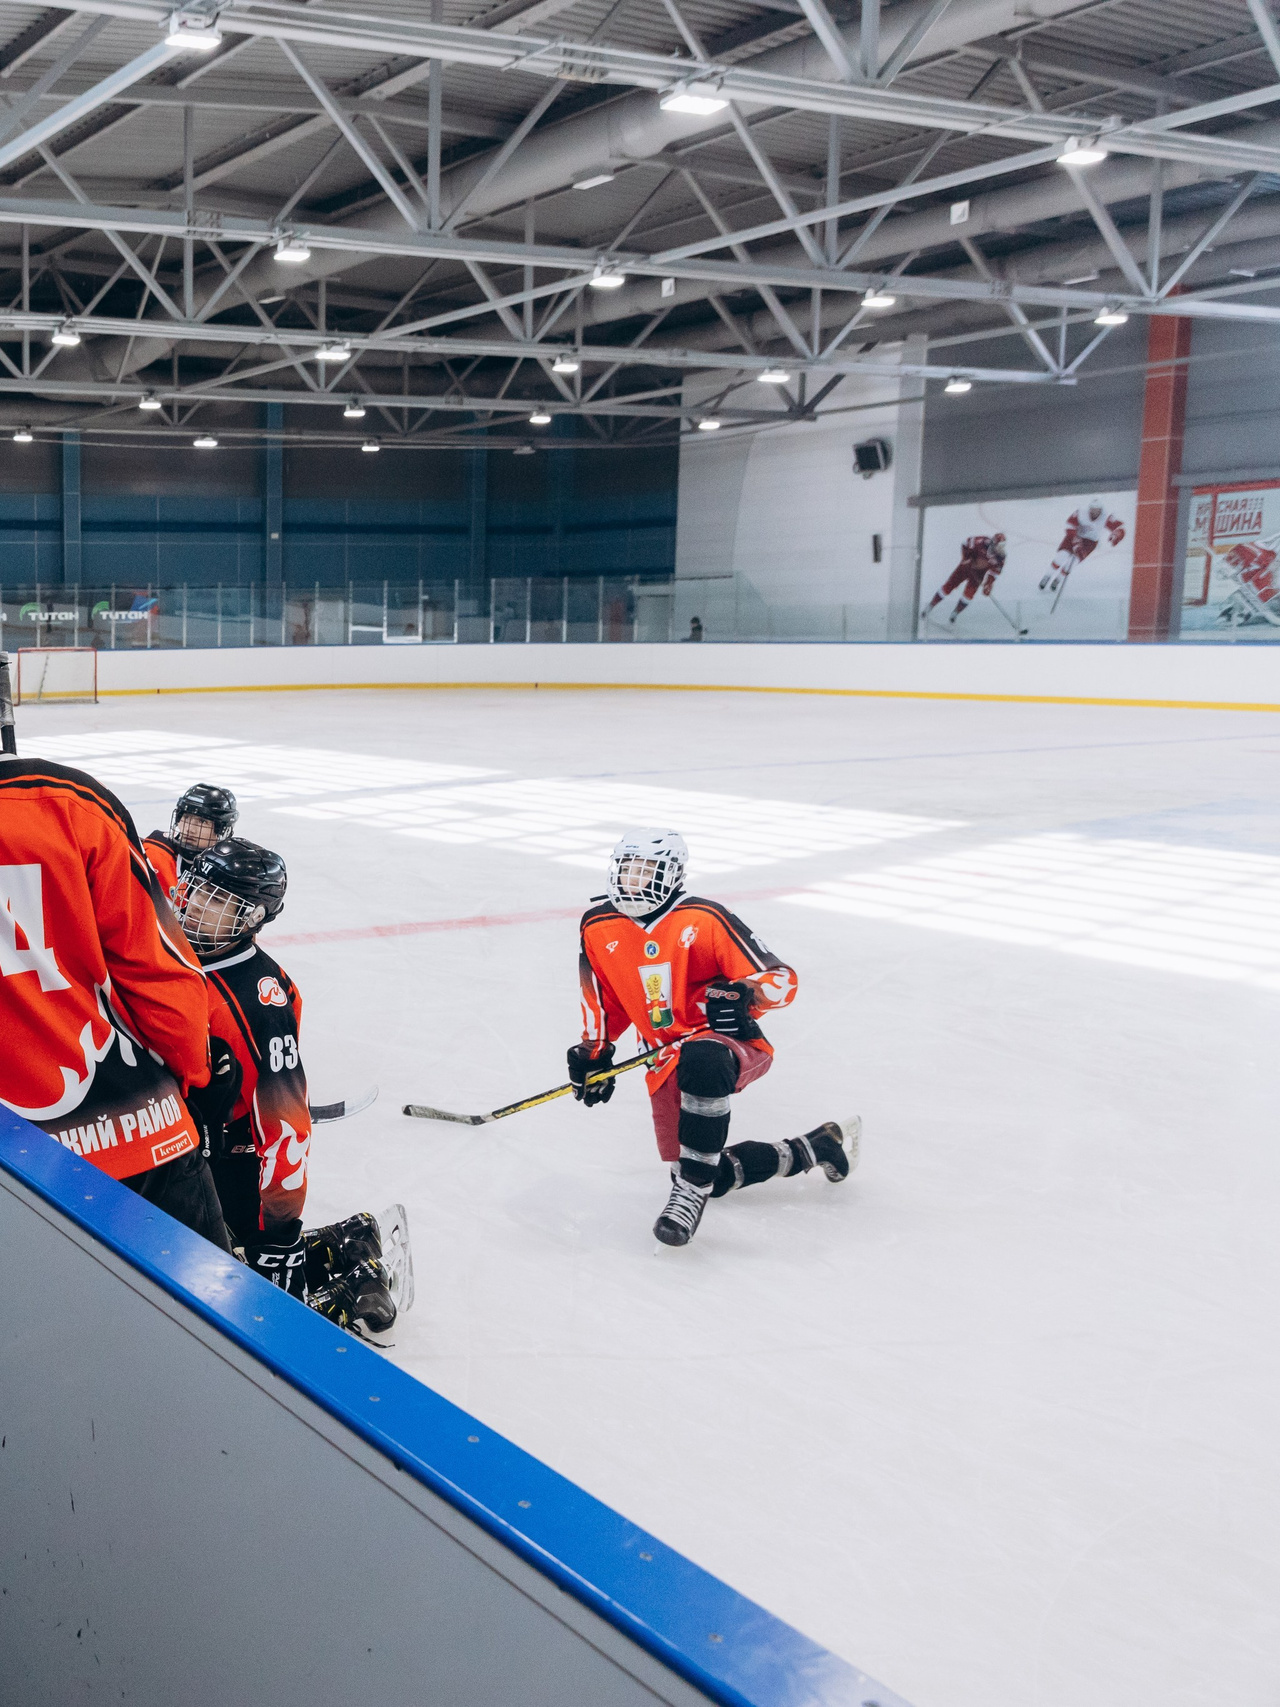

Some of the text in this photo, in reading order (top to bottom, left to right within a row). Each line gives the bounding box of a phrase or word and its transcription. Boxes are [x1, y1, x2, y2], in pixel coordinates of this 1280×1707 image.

[1196, 498, 1248, 515] КРСНАЯ
[1194, 511, 1262, 535] МШИНА
[268, 1034, 299, 1073] 83
[119, 1093, 183, 1143] РАЙОН
[159, 1137, 189, 1157] keeper
[257, 1251, 304, 1268] CC
